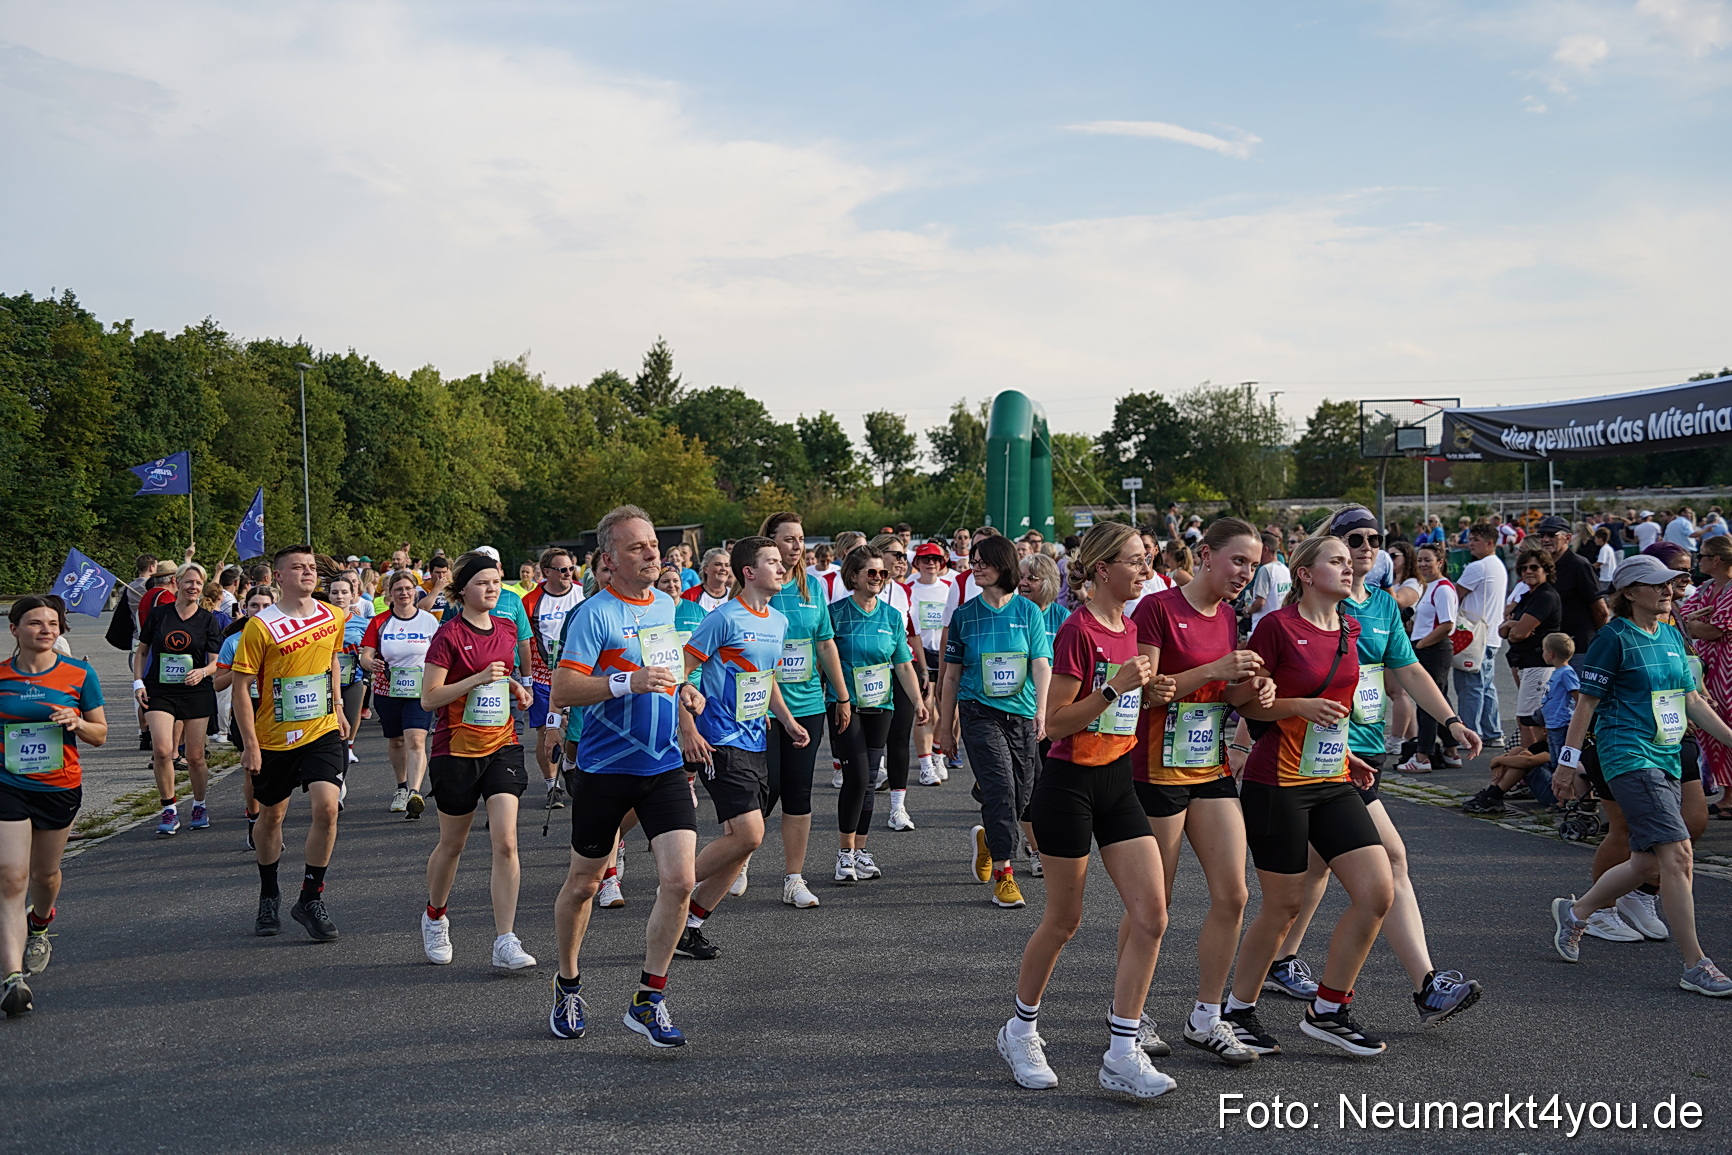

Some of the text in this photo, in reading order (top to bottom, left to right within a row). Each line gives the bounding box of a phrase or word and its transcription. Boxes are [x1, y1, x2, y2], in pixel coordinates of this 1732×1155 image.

[1501, 402, 1732, 457] Hier gewinnt das Miteina
[279, 624, 338, 656] MAX BÖGL
[946, 645, 956, 653] 26
[650, 649, 679, 666] 2243
[782, 657, 804, 666] 1077
[993, 671, 1015, 680] 1071
[1598, 674, 1609, 685] 26
[864, 681, 884, 692] 1078
[294, 693, 317, 704] 1612
[744, 690, 766, 702] 2230
[1359, 688, 1378, 702] 1085
[476, 697, 501, 707] 1265
[1660, 712, 1679, 725] 1089
[1188, 729, 1213, 743] 1262
[20, 743, 47, 755] 479
[1317, 741, 1344, 755] 1264
